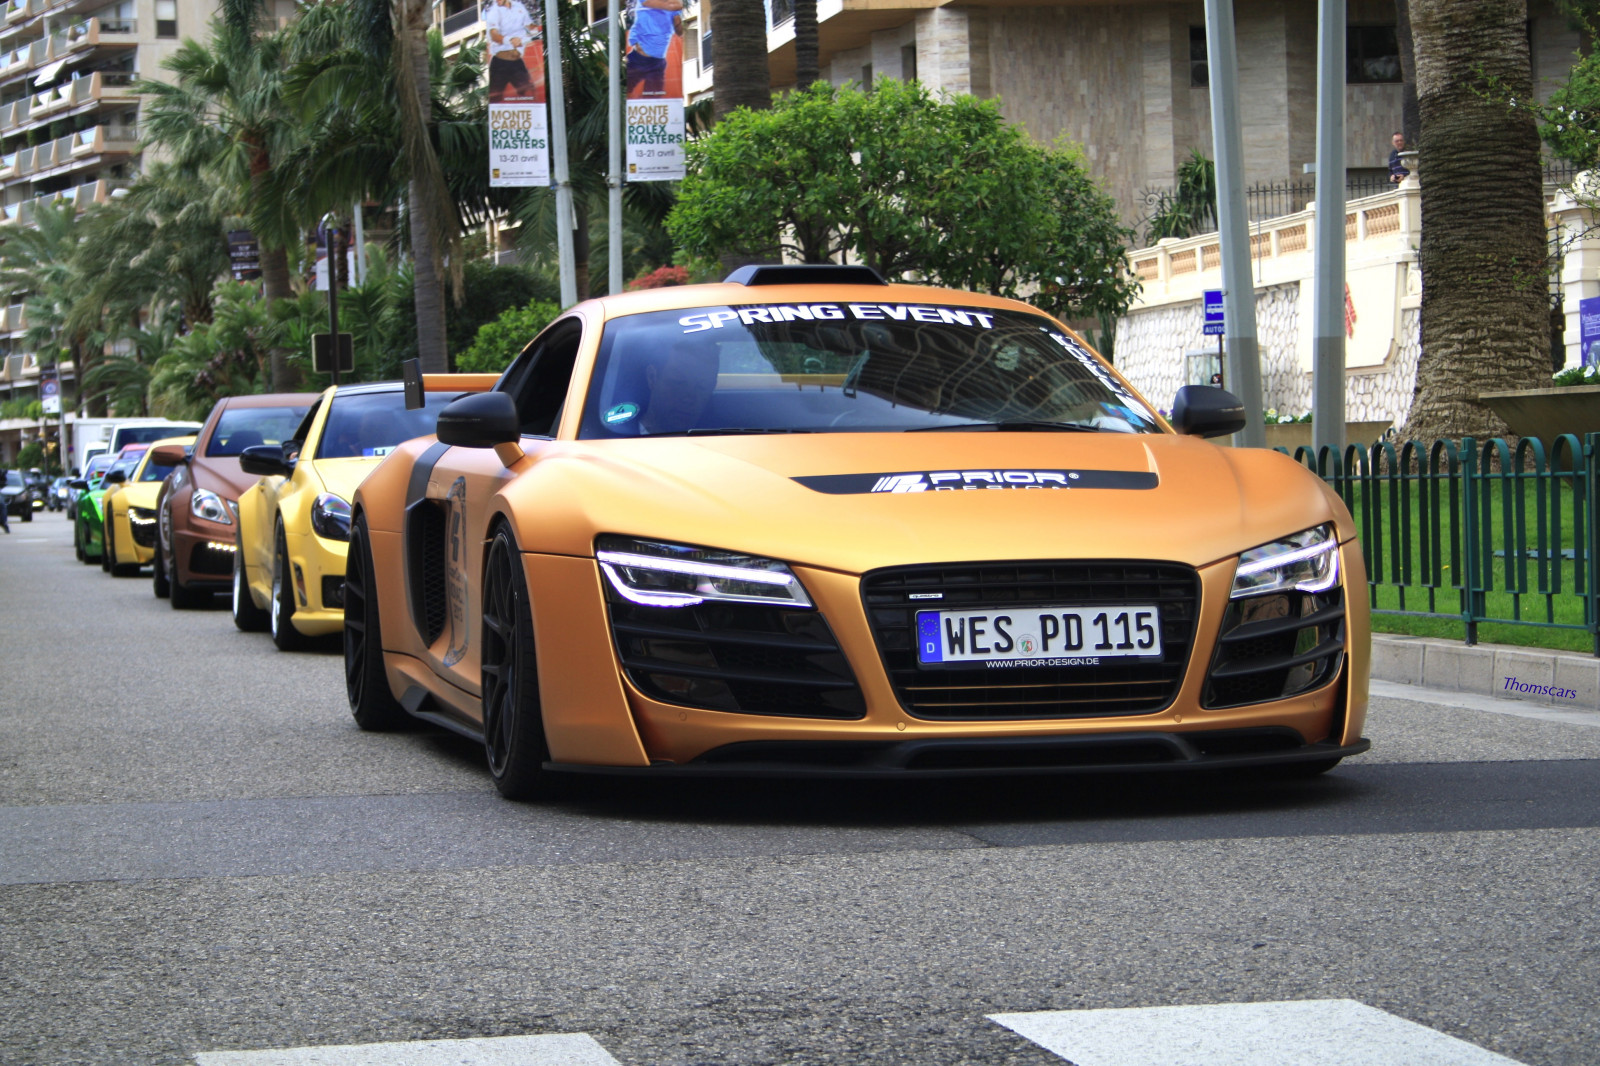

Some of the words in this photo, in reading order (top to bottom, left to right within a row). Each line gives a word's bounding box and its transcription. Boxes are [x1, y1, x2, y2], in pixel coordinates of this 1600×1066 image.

[491, 110, 532, 120] MONTE
[628, 104, 668, 116] MONTE
[491, 120, 532, 130] CARLO
[628, 115, 668, 125] CARLO
[492, 129, 530, 140] ROLEX
[628, 125, 667, 135] ROLEX
[492, 139, 546, 150] MASTERS
[628, 134, 682, 145] MASTERS
[499, 154, 519, 163] 13-21
[520, 154, 538, 162] avril
[635, 149, 655, 158] 13-21
[657, 149, 675, 157] avril
[678, 304, 844, 334] SPRING
[849, 303, 994, 329] EVENT
[929, 471, 1068, 485] PRIOR
[945, 615, 1014, 654] WES
[1039, 613, 1083, 651] PD
[1093, 612, 1155, 650] 115
[926, 642, 935, 653] D
[986, 657, 1100, 668] WWW.PRIOR-DESIGN.DE
